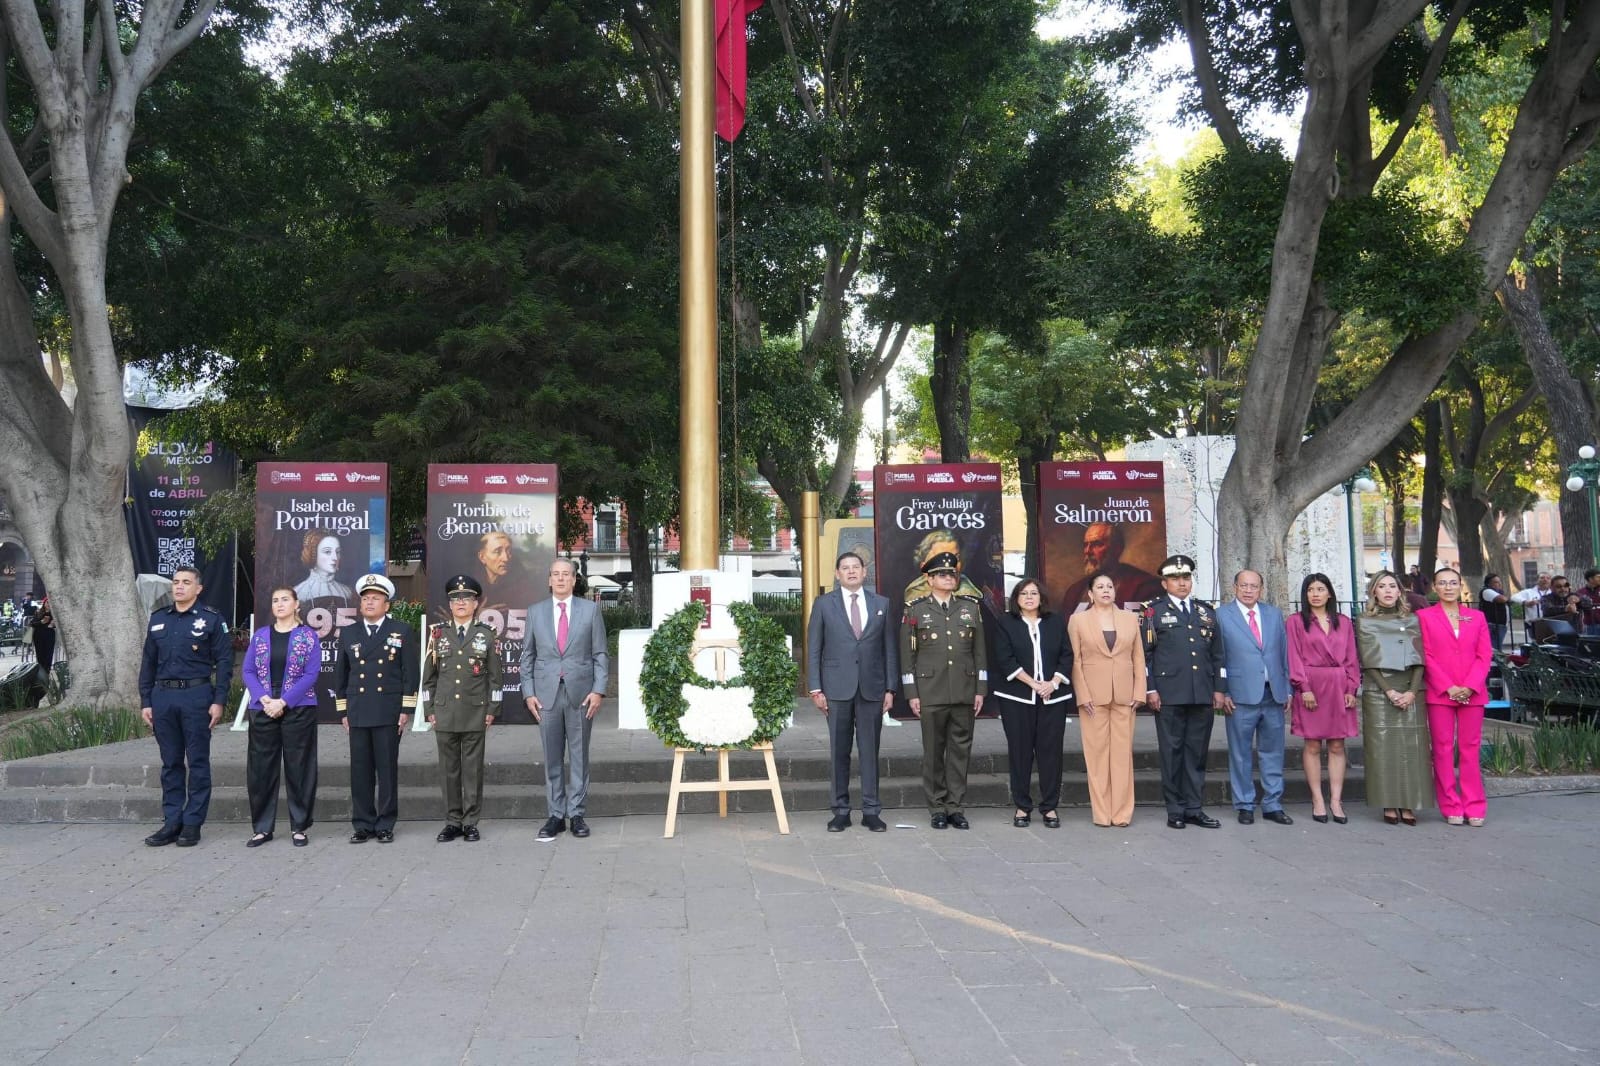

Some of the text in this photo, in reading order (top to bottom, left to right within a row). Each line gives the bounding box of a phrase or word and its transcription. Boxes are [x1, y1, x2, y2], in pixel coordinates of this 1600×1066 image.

[157, 474, 200, 485] 11 al 19
[149, 488, 208, 498] de ABRIL
[291, 498, 356, 512] Isabel de
[912, 498, 973, 512] Fray Julián
[1104, 496, 1150, 508] Juan de
[151, 509, 178, 517] 07:00
[453, 502, 532, 517] Toribio de
[1055, 503, 1152, 524] Salmerón
[157, 519, 180, 527] 11:00
[275, 510, 370, 536] Portugal
[896, 506, 986, 530] Garcés
[439, 517, 545, 538] Benavente
